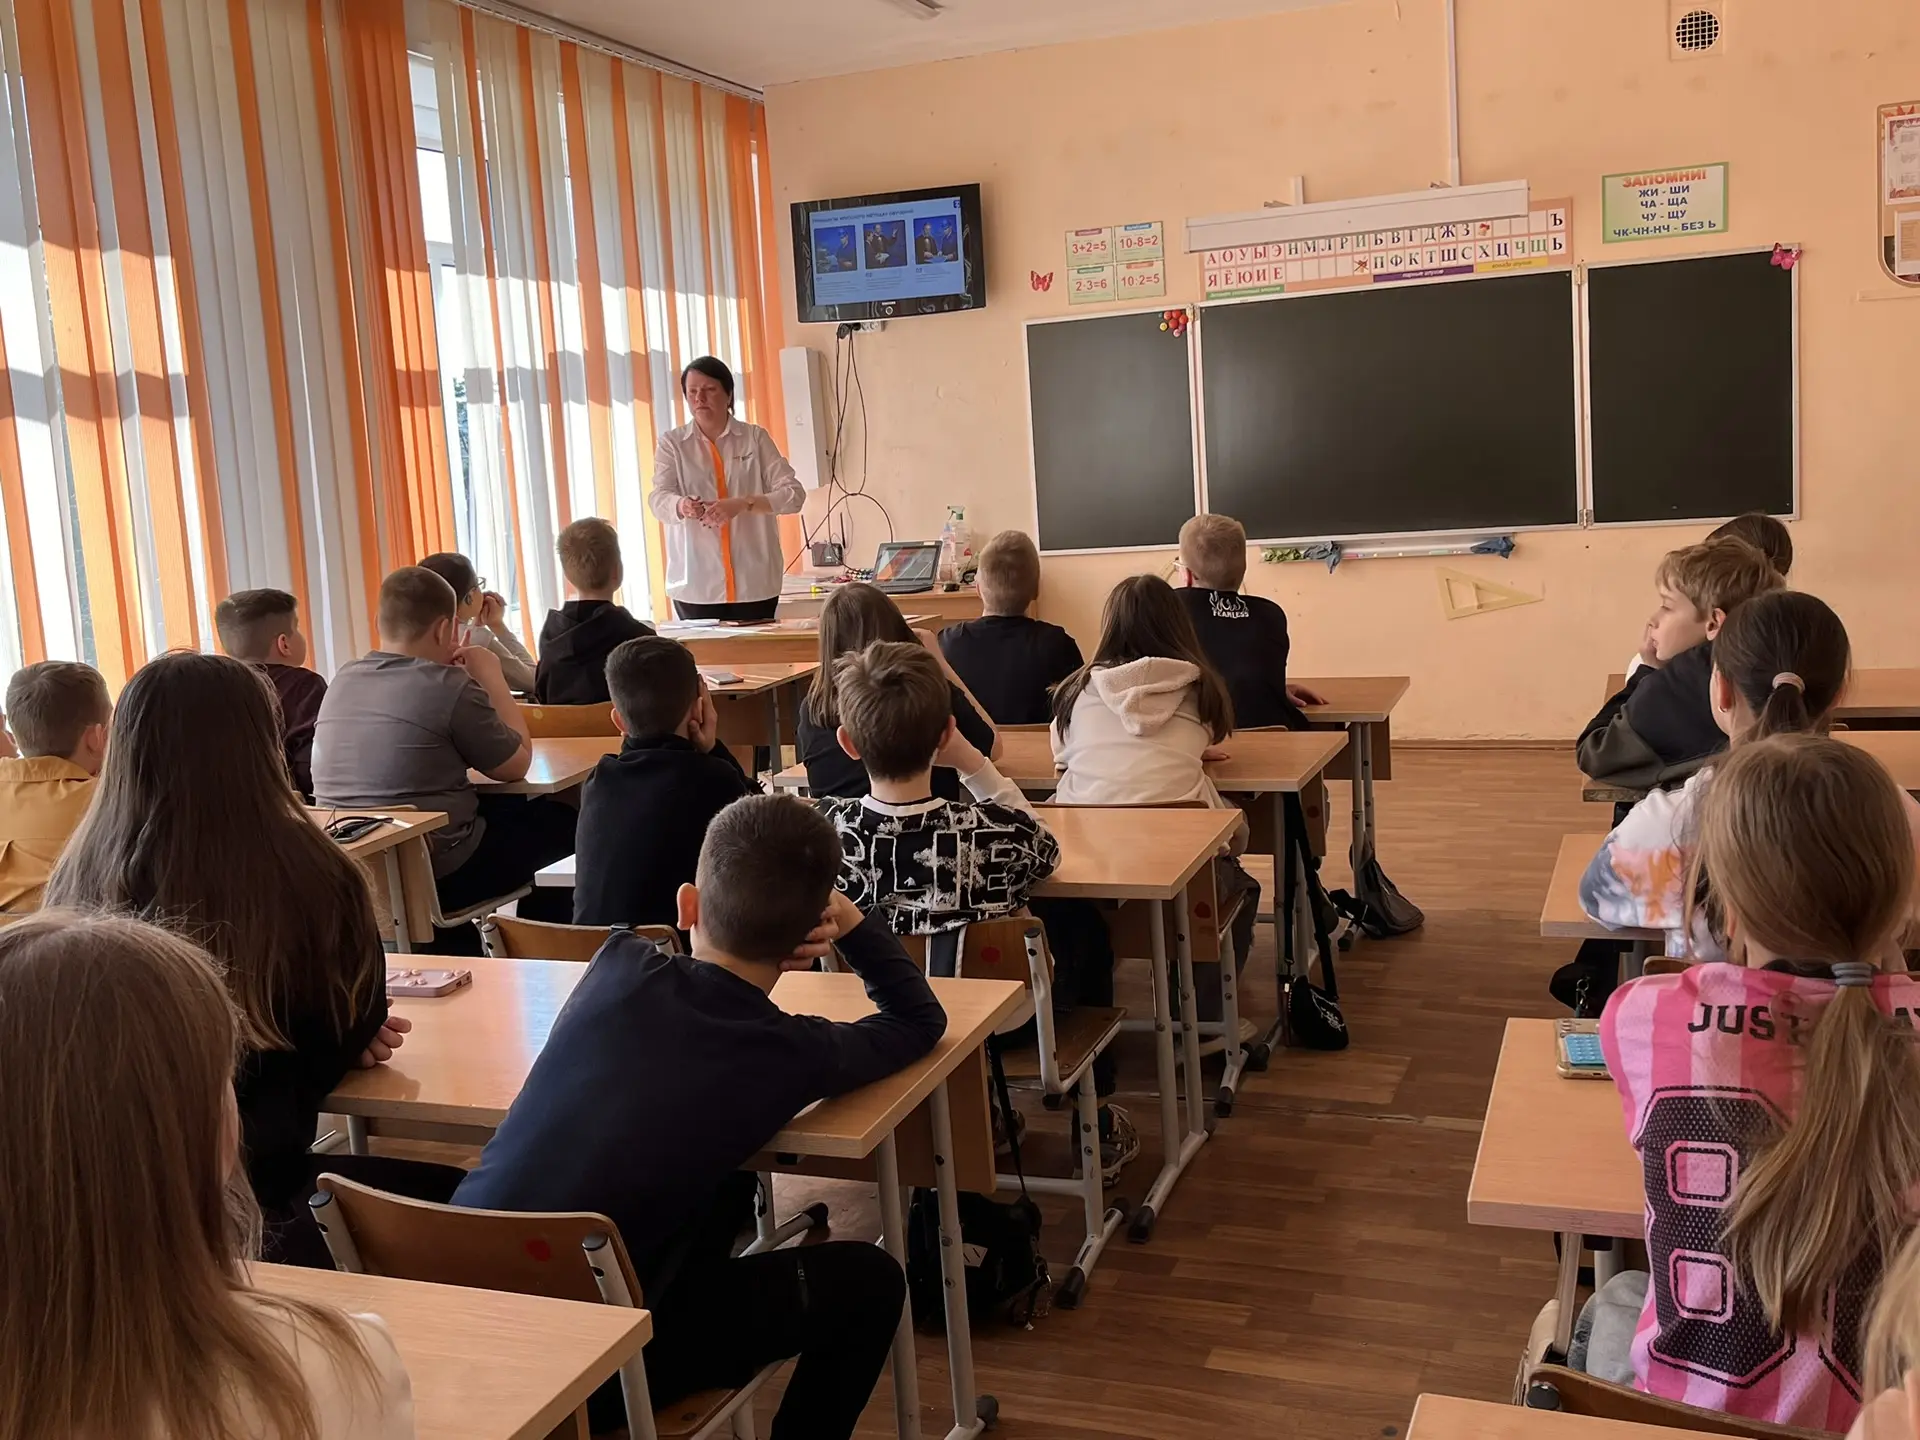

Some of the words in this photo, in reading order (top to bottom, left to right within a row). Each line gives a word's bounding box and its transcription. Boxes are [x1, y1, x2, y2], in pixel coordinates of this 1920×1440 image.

[1622, 169, 1707, 188] ЗАПОМНИ!
[1639, 188, 1659, 197] ЖИ
[1669, 185, 1690, 195] ШИ
[1640, 199, 1657, 208] ЧА
[1667, 197, 1688, 207] ЩА
[1641, 212, 1657, 221] ЧУ
[1667, 210, 1687, 219] ЩУ
[1613, 225, 1670, 237] ЧК-ЧН-НЧ
[1681, 221, 1704, 231] БЕЗ
[1708, 220, 1716, 229] Ь
[1119, 235, 1158, 249] 10-8=2
[1206, 252, 1217, 265] А
[1222, 250, 1233, 262] О
[1239, 247, 1248, 260] У
[1254, 246, 1267, 259] Ы
[1272, 244, 1282, 257] Э
[1288, 242, 1298, 255] Н
[1304, 240, 1316, 254] М
[1321, 239, 1332, 251] Л
[1340, 237, 1348, 249] Р
[1391, 231, 1401, 244] В
[1424, 227, 1436, 242] Д
[1440, 223, 1456, 238] Ж
[1462, 223, 1470, 236] З
[1551, 213, 1563, 226] Ъ
[1072, 240, 1107, 254] 3+2=5
[1208, 274, 1217, 287] Я
[1225, 269, 1234, 285] Ё
[1238, 270, 1253, 284] Ю
[1256, 269, 1266, 281] И
[1274, 267, 1283, 280] Е
[1374, 256, 1385, 269] П
[1390, 254, 1403, 267] Ф
[1409, 252, 1420, 265] К
[1426, 250, 1436, 263] Т
[1441, 248, 1456, 262] Ш
[1461, 246, 1472, 260] С
[1479, 245, 1490, 258] Х
[1497, 243, 1509, 257] Ц
[1515, 241, 1525, 253] Ч
[1531, 239, 1548, 254] Щ
[1552, 237, 1562, 250] Ь
[1121, 273, 1160, 287] 10:2=5
[1212, 610, 1249, 619] FEARLESS
